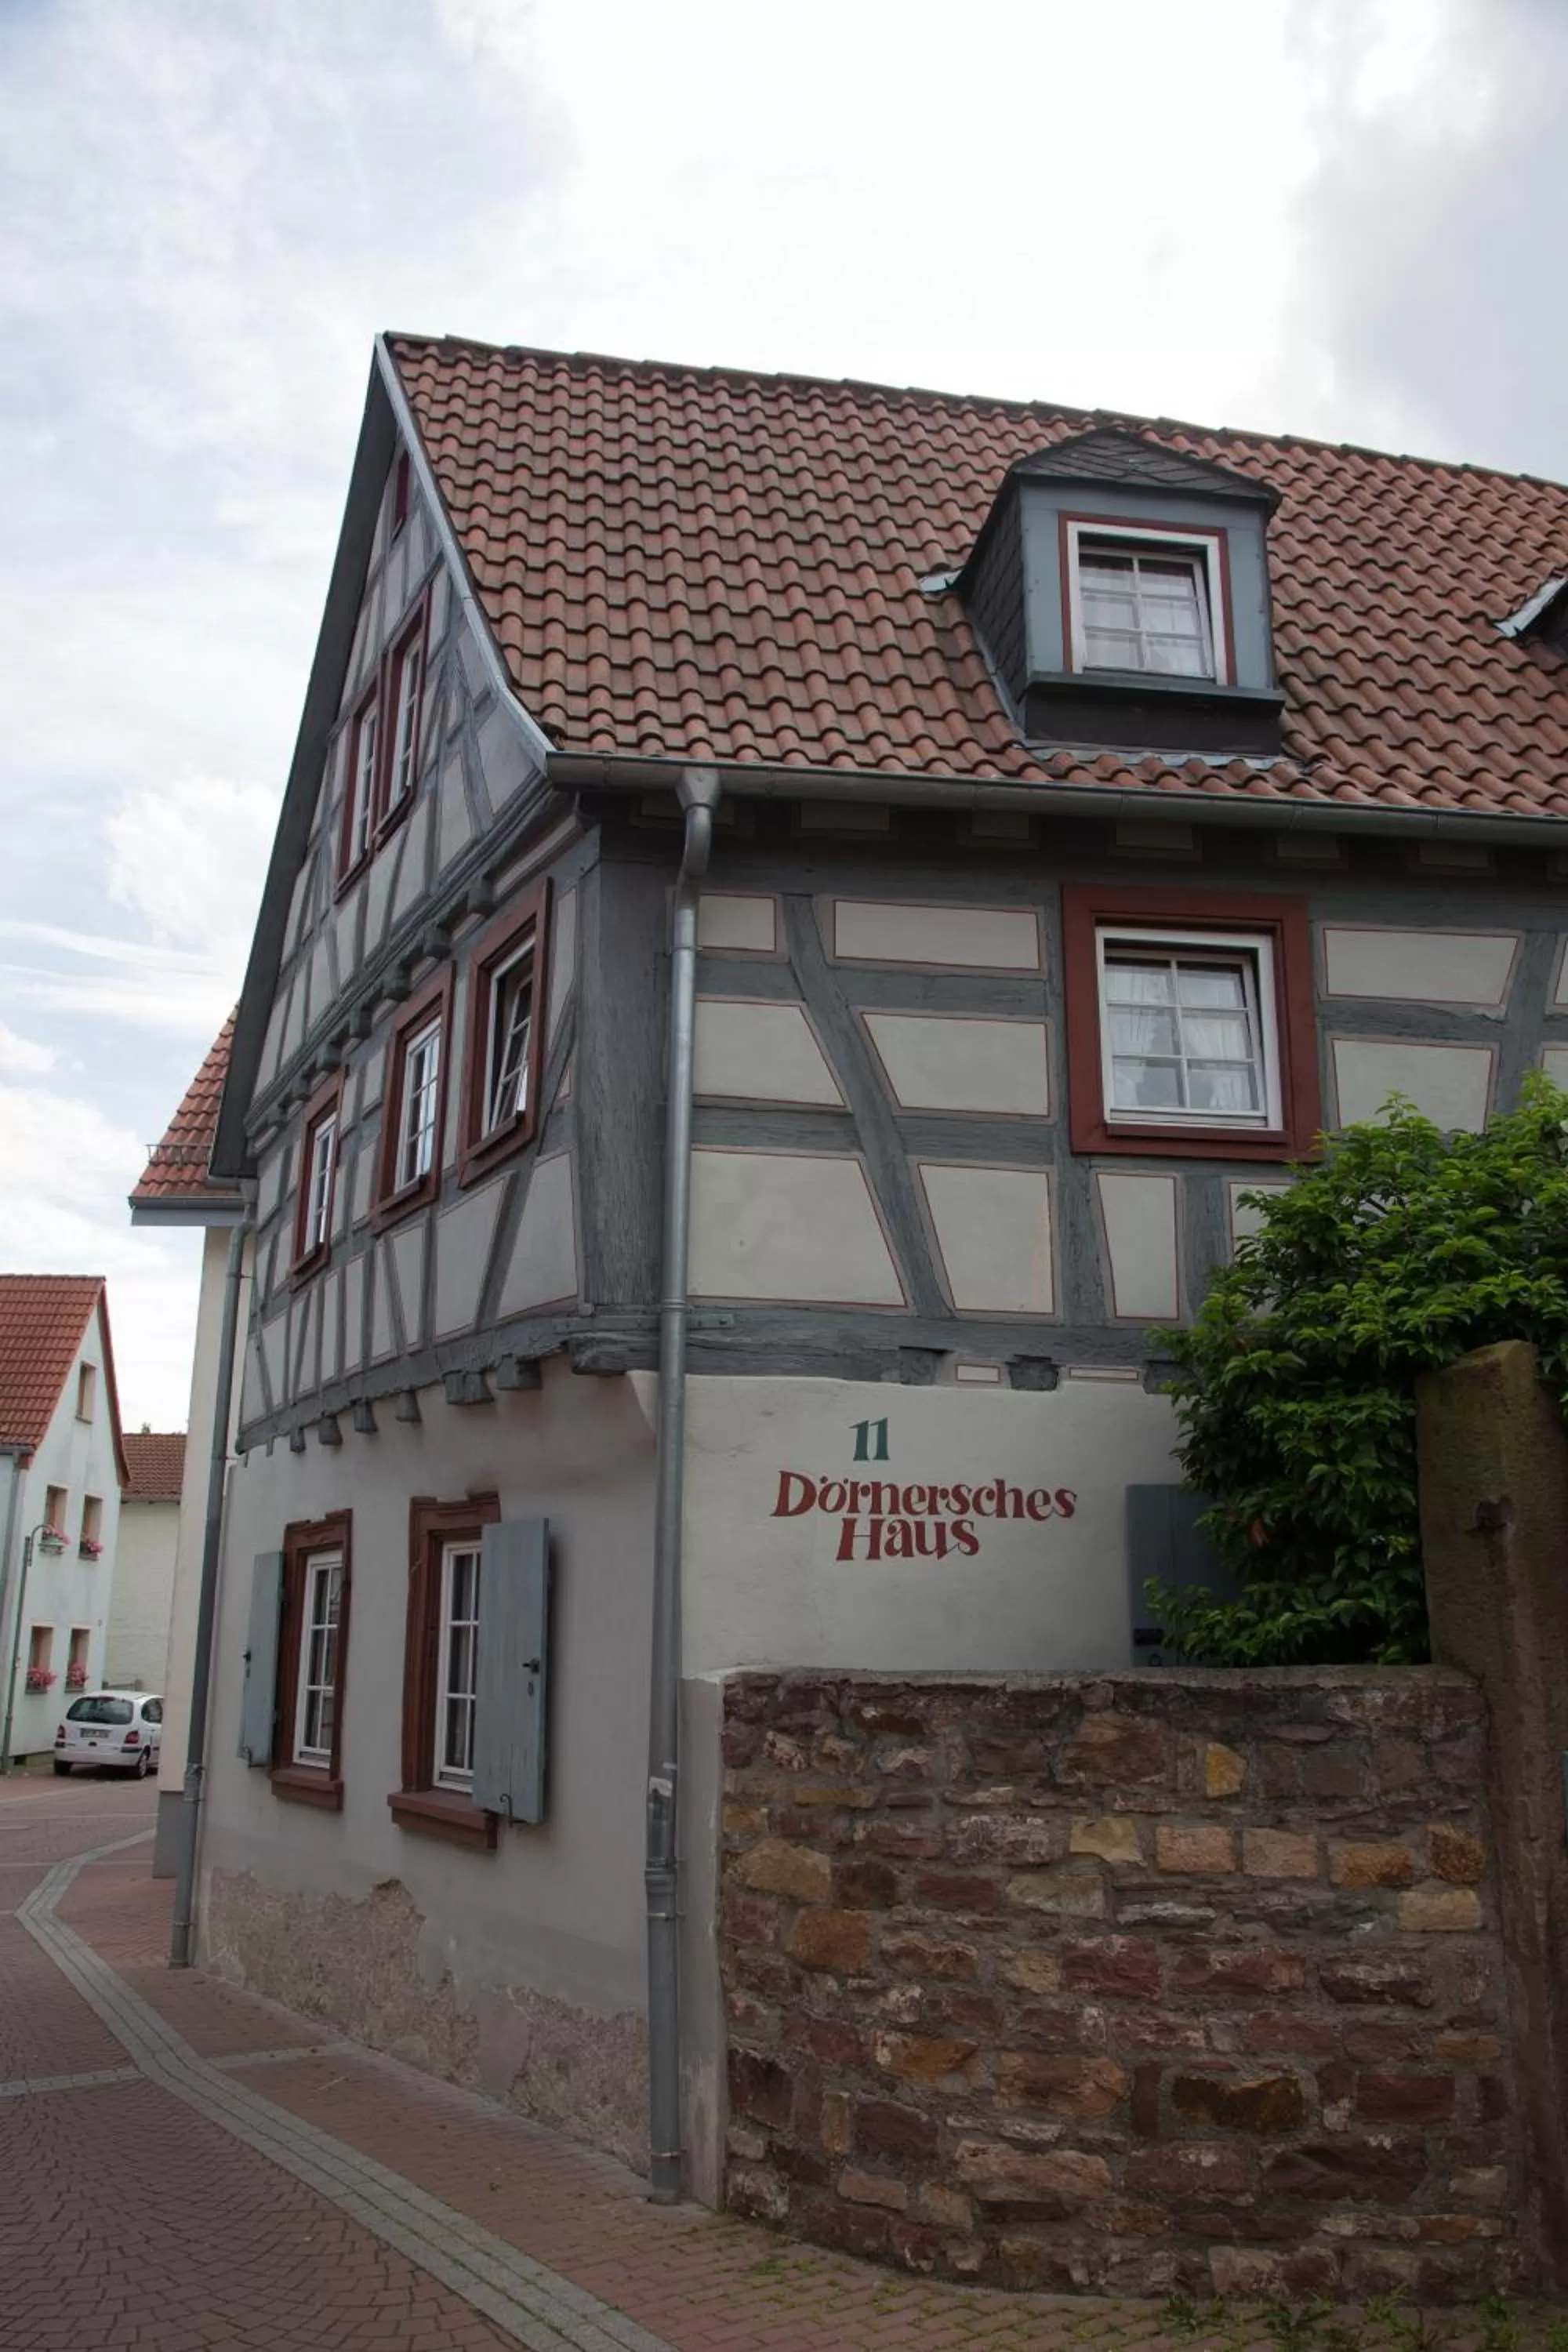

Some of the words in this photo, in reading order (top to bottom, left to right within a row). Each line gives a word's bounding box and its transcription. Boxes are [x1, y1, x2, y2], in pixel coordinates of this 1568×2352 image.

[848, 1417, 890, 1461] 11
[770, 1471, 1077, 1521] Dörnersches
[836, 1517, 980, 1561] Haus
